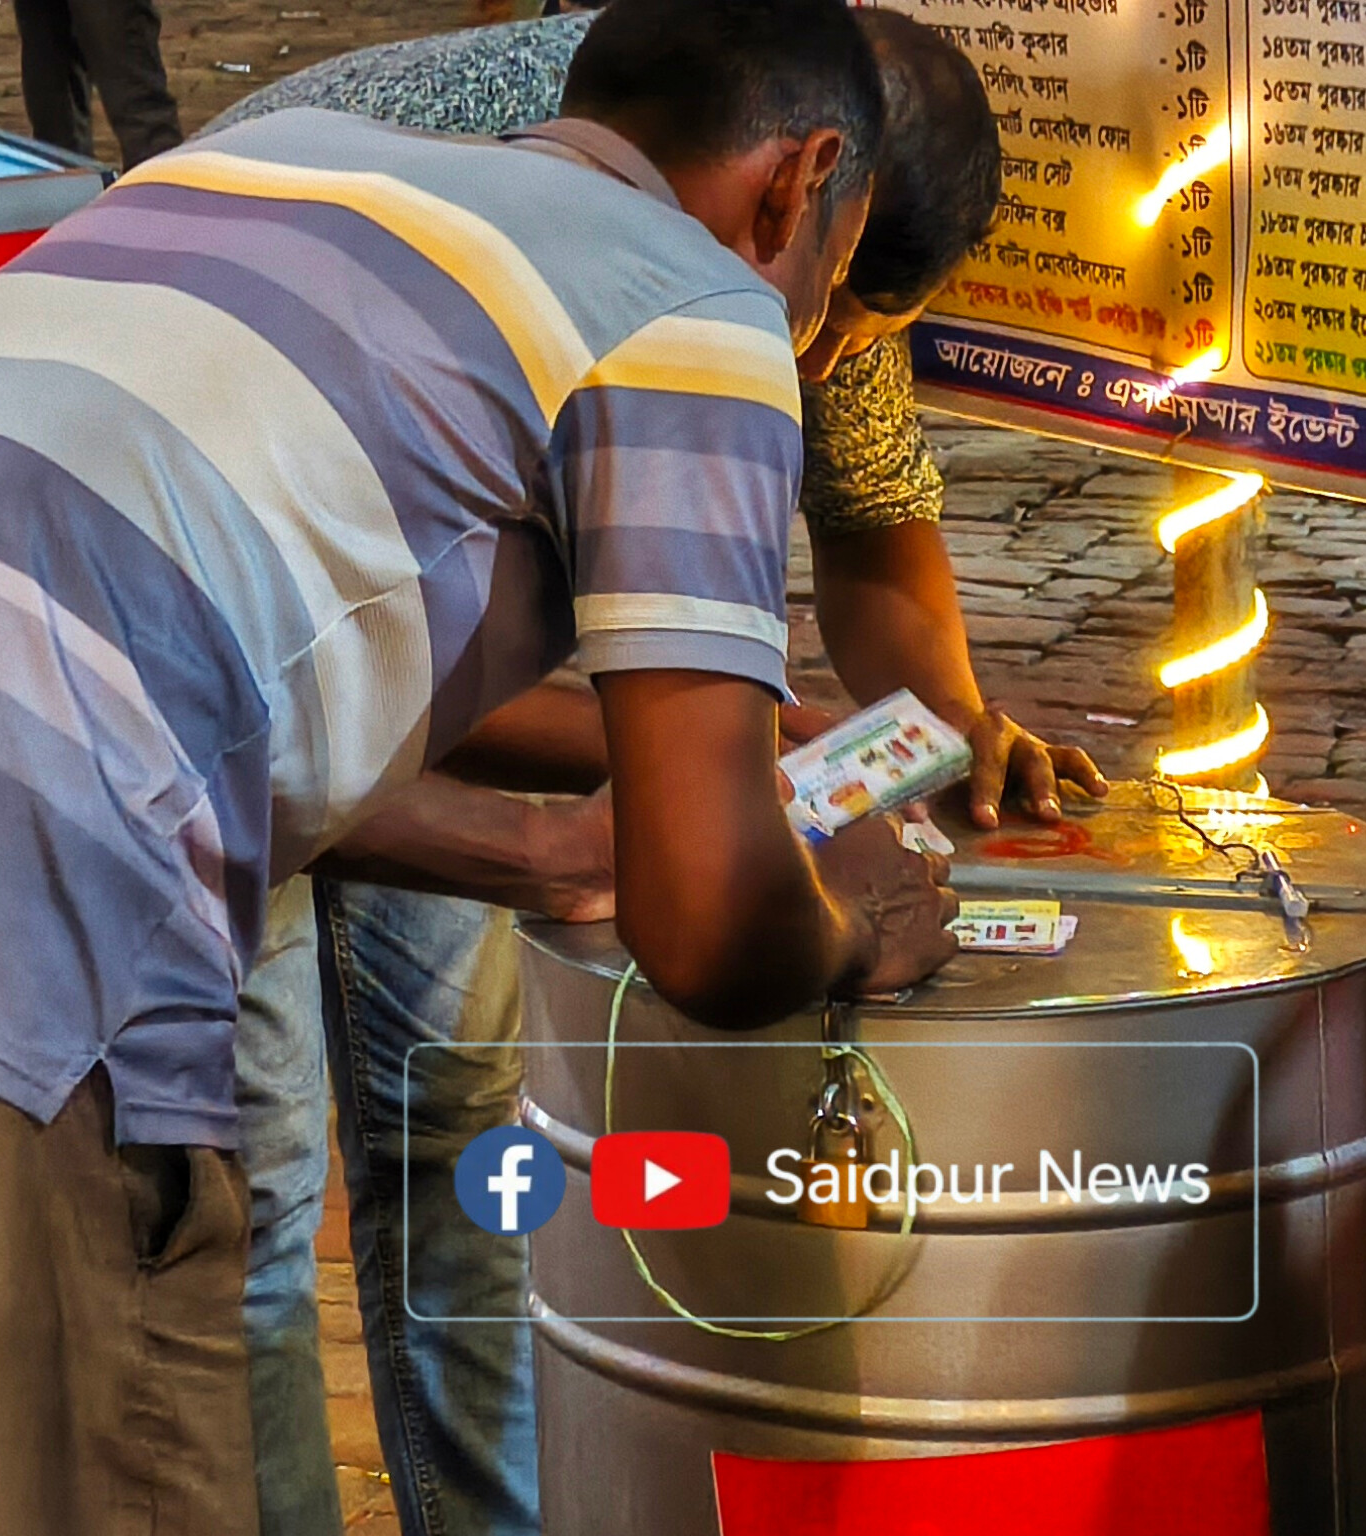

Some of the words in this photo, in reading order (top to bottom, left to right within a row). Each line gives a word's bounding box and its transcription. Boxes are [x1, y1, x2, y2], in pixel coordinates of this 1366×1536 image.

[1043, 155, 1074, 187] সেট
[933, 337, 1072, 393] আয়োজনে
[1267, 397, 1361, 450] ইভেন্ট
